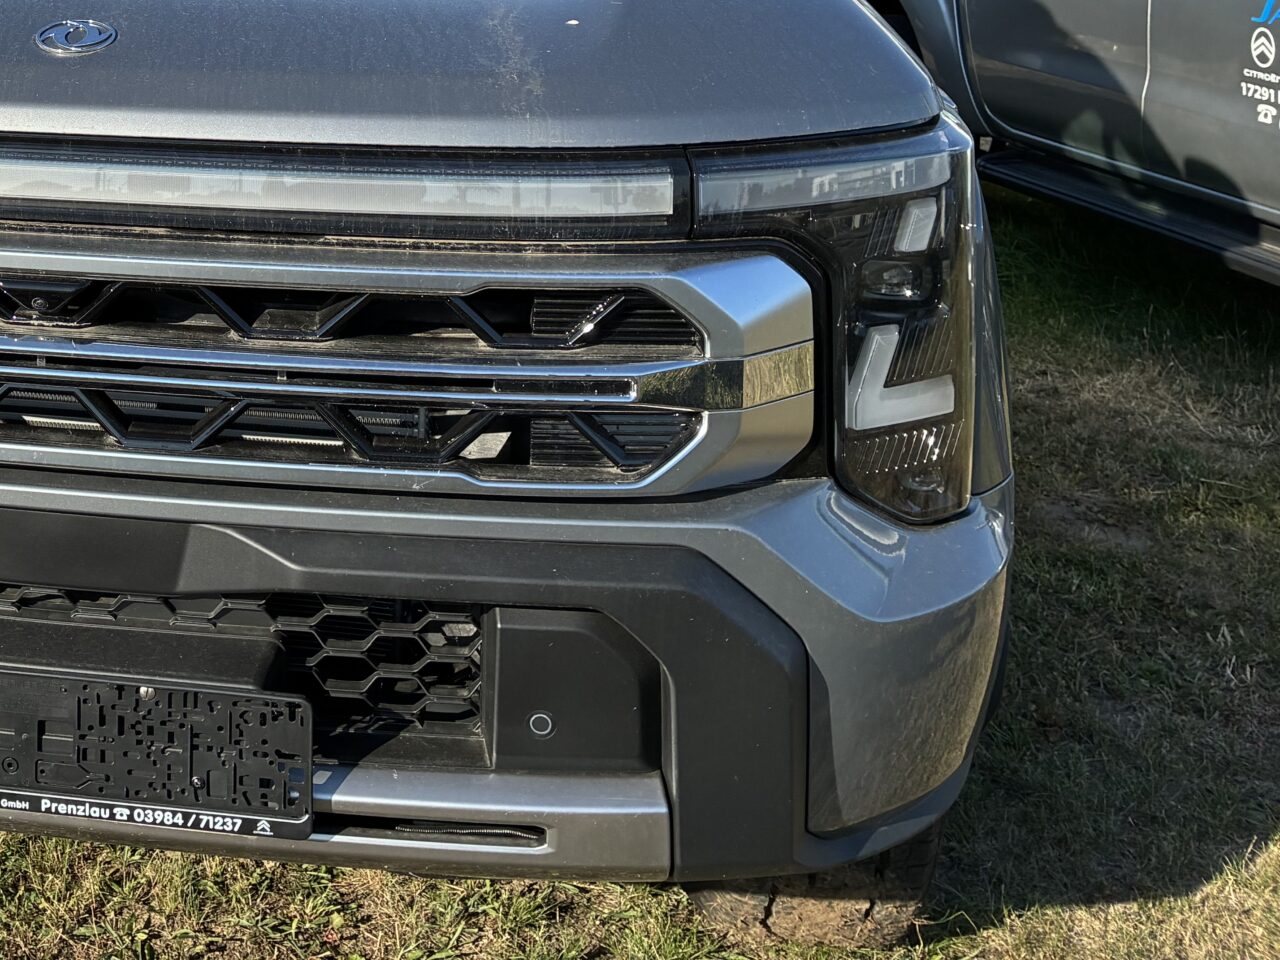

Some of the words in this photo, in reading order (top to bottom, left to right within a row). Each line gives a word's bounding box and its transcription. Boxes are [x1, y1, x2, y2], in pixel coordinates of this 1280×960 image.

[1240, 81, 1275, 103] 17291
[0, 798, 30, 810] GmbH
[40, 798, 110, 819] Prenzlau
[133, 808, 185, 827] 03984
[187, 814, 196, 828] /
[199, 814, 243, 832] 71237
